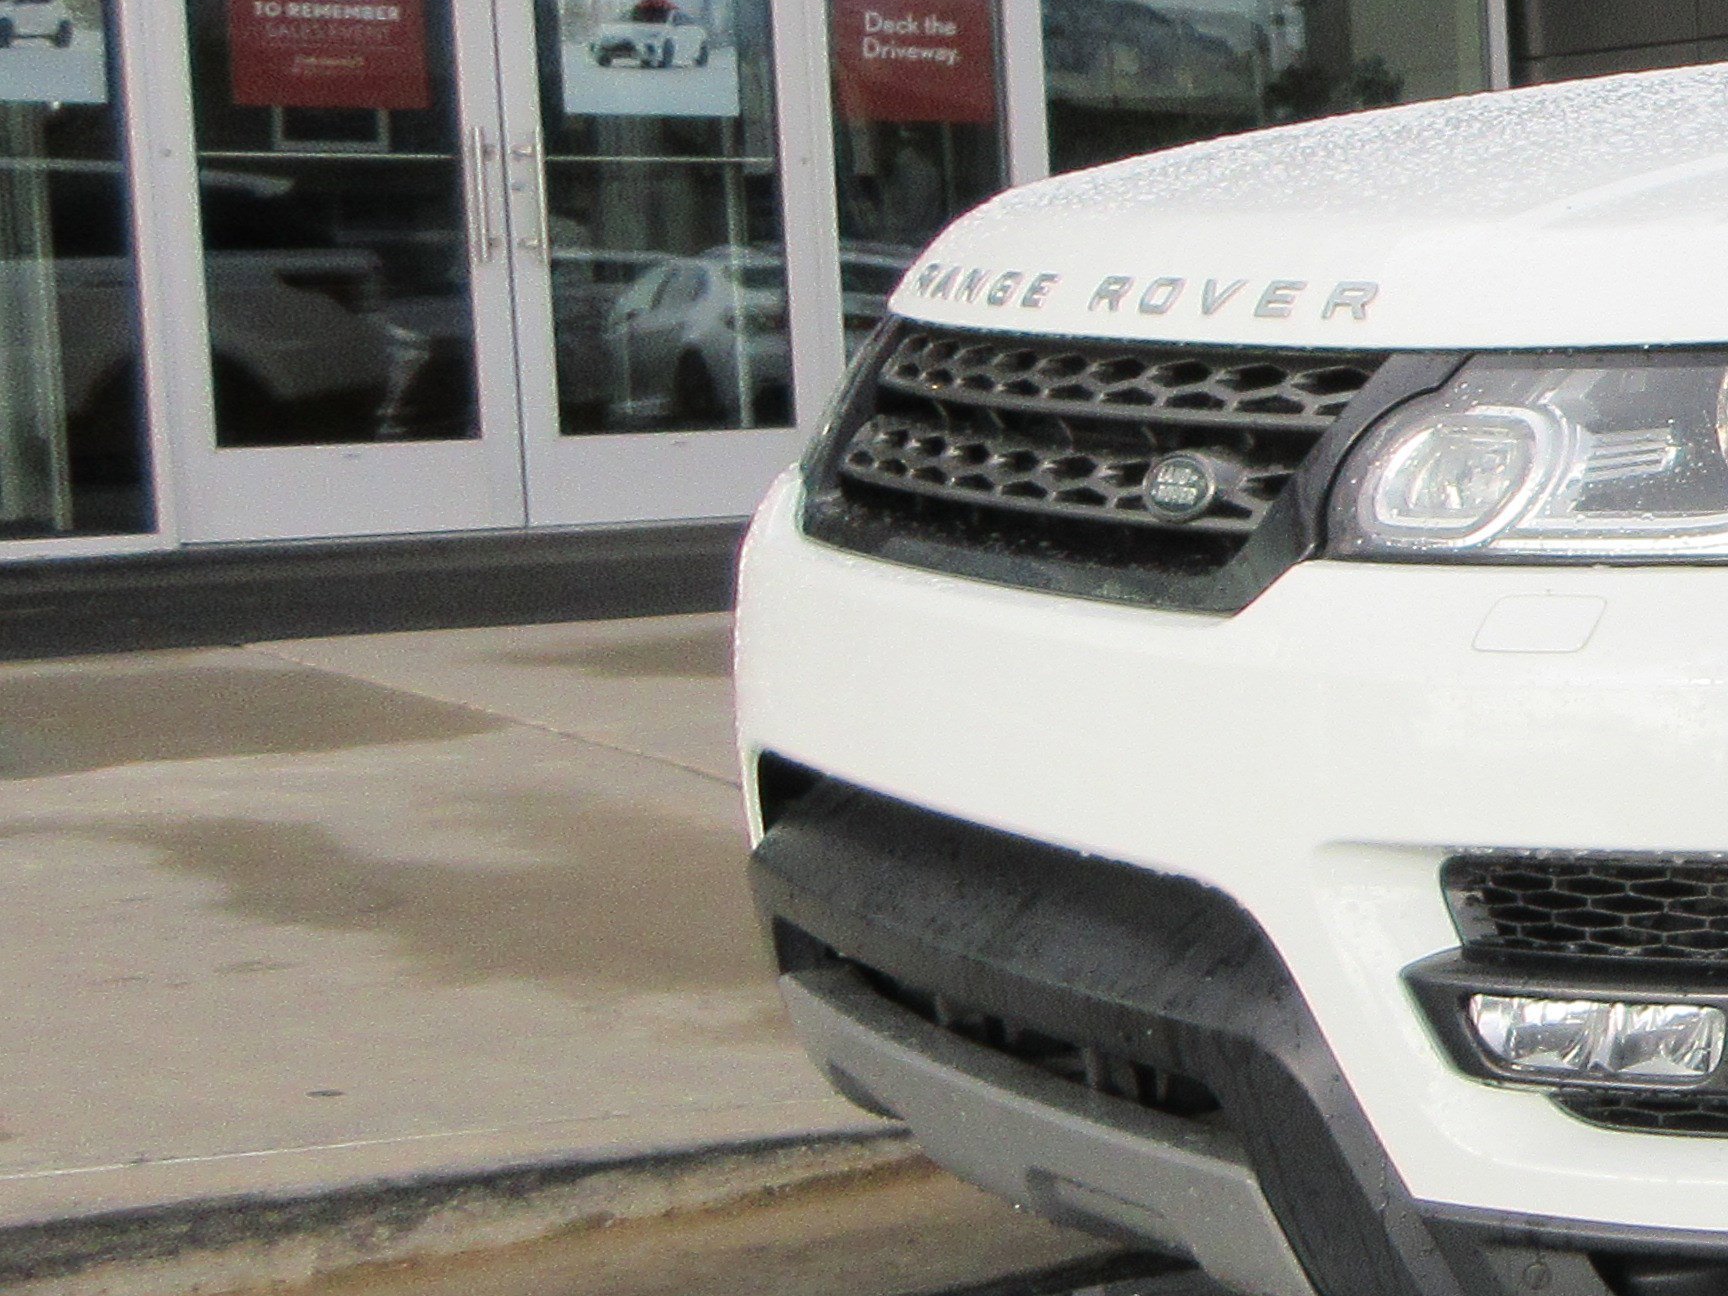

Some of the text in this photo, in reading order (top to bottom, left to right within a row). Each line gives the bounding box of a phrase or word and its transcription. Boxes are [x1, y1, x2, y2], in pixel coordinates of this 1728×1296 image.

[254, 1, 400, 21] TO REMEMBER
[864, 11, 958, 36] Deck the
[916, 261, 1381, 322] RANGE ROVER
